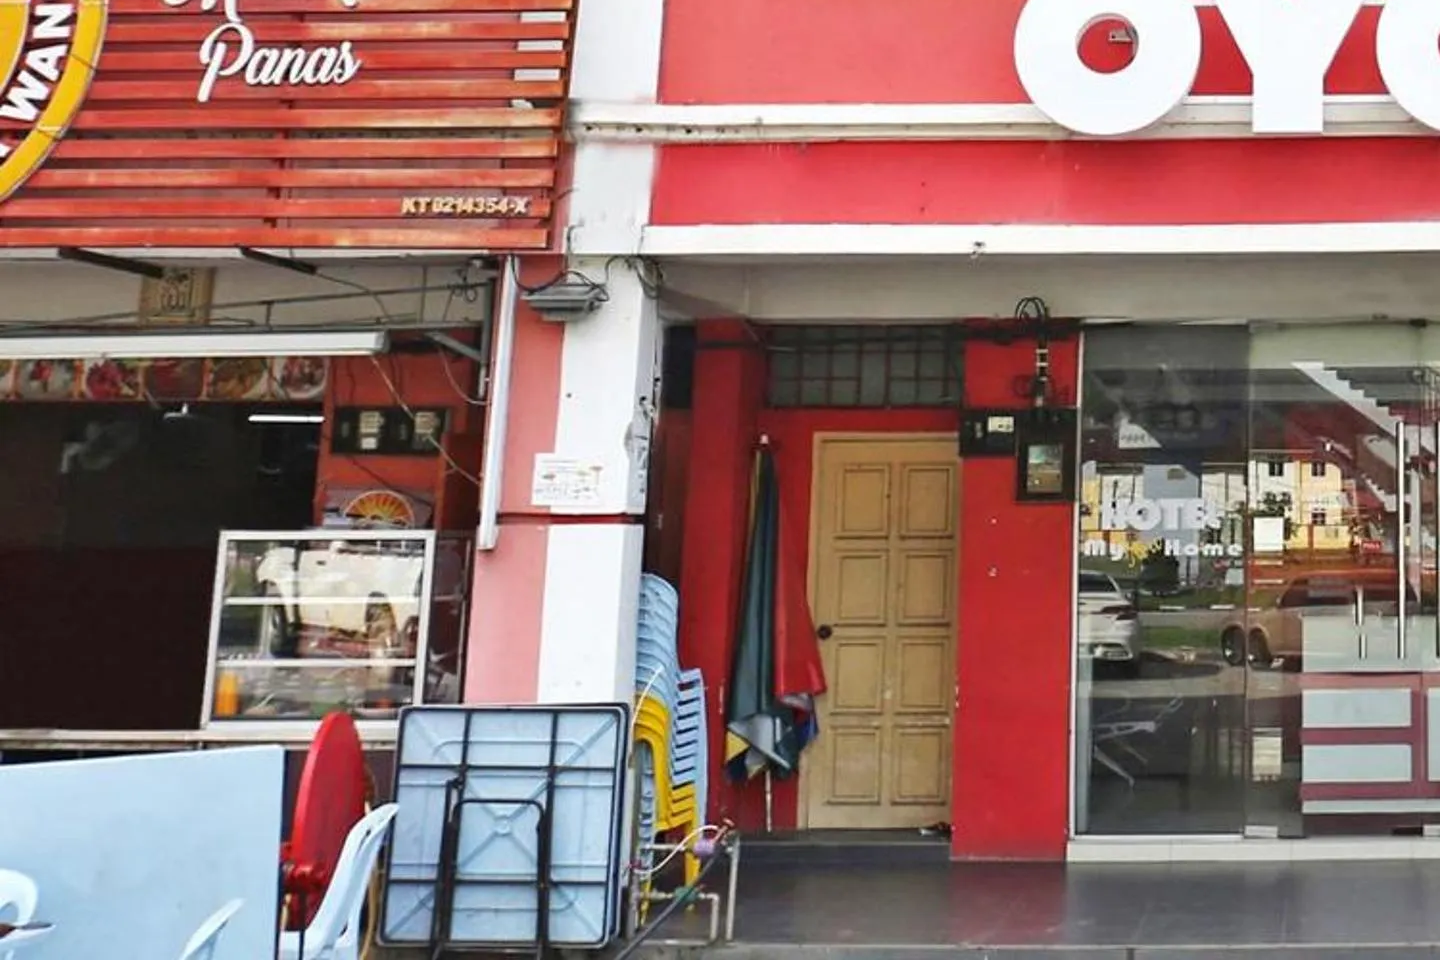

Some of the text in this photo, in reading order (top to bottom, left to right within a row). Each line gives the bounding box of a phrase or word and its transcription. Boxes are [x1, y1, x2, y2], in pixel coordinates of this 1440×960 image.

[197, 23, 362, 102] Panas
[1102, 498, 1222, 531] HOTEL
[1164, 539, 1244, 557] Home
